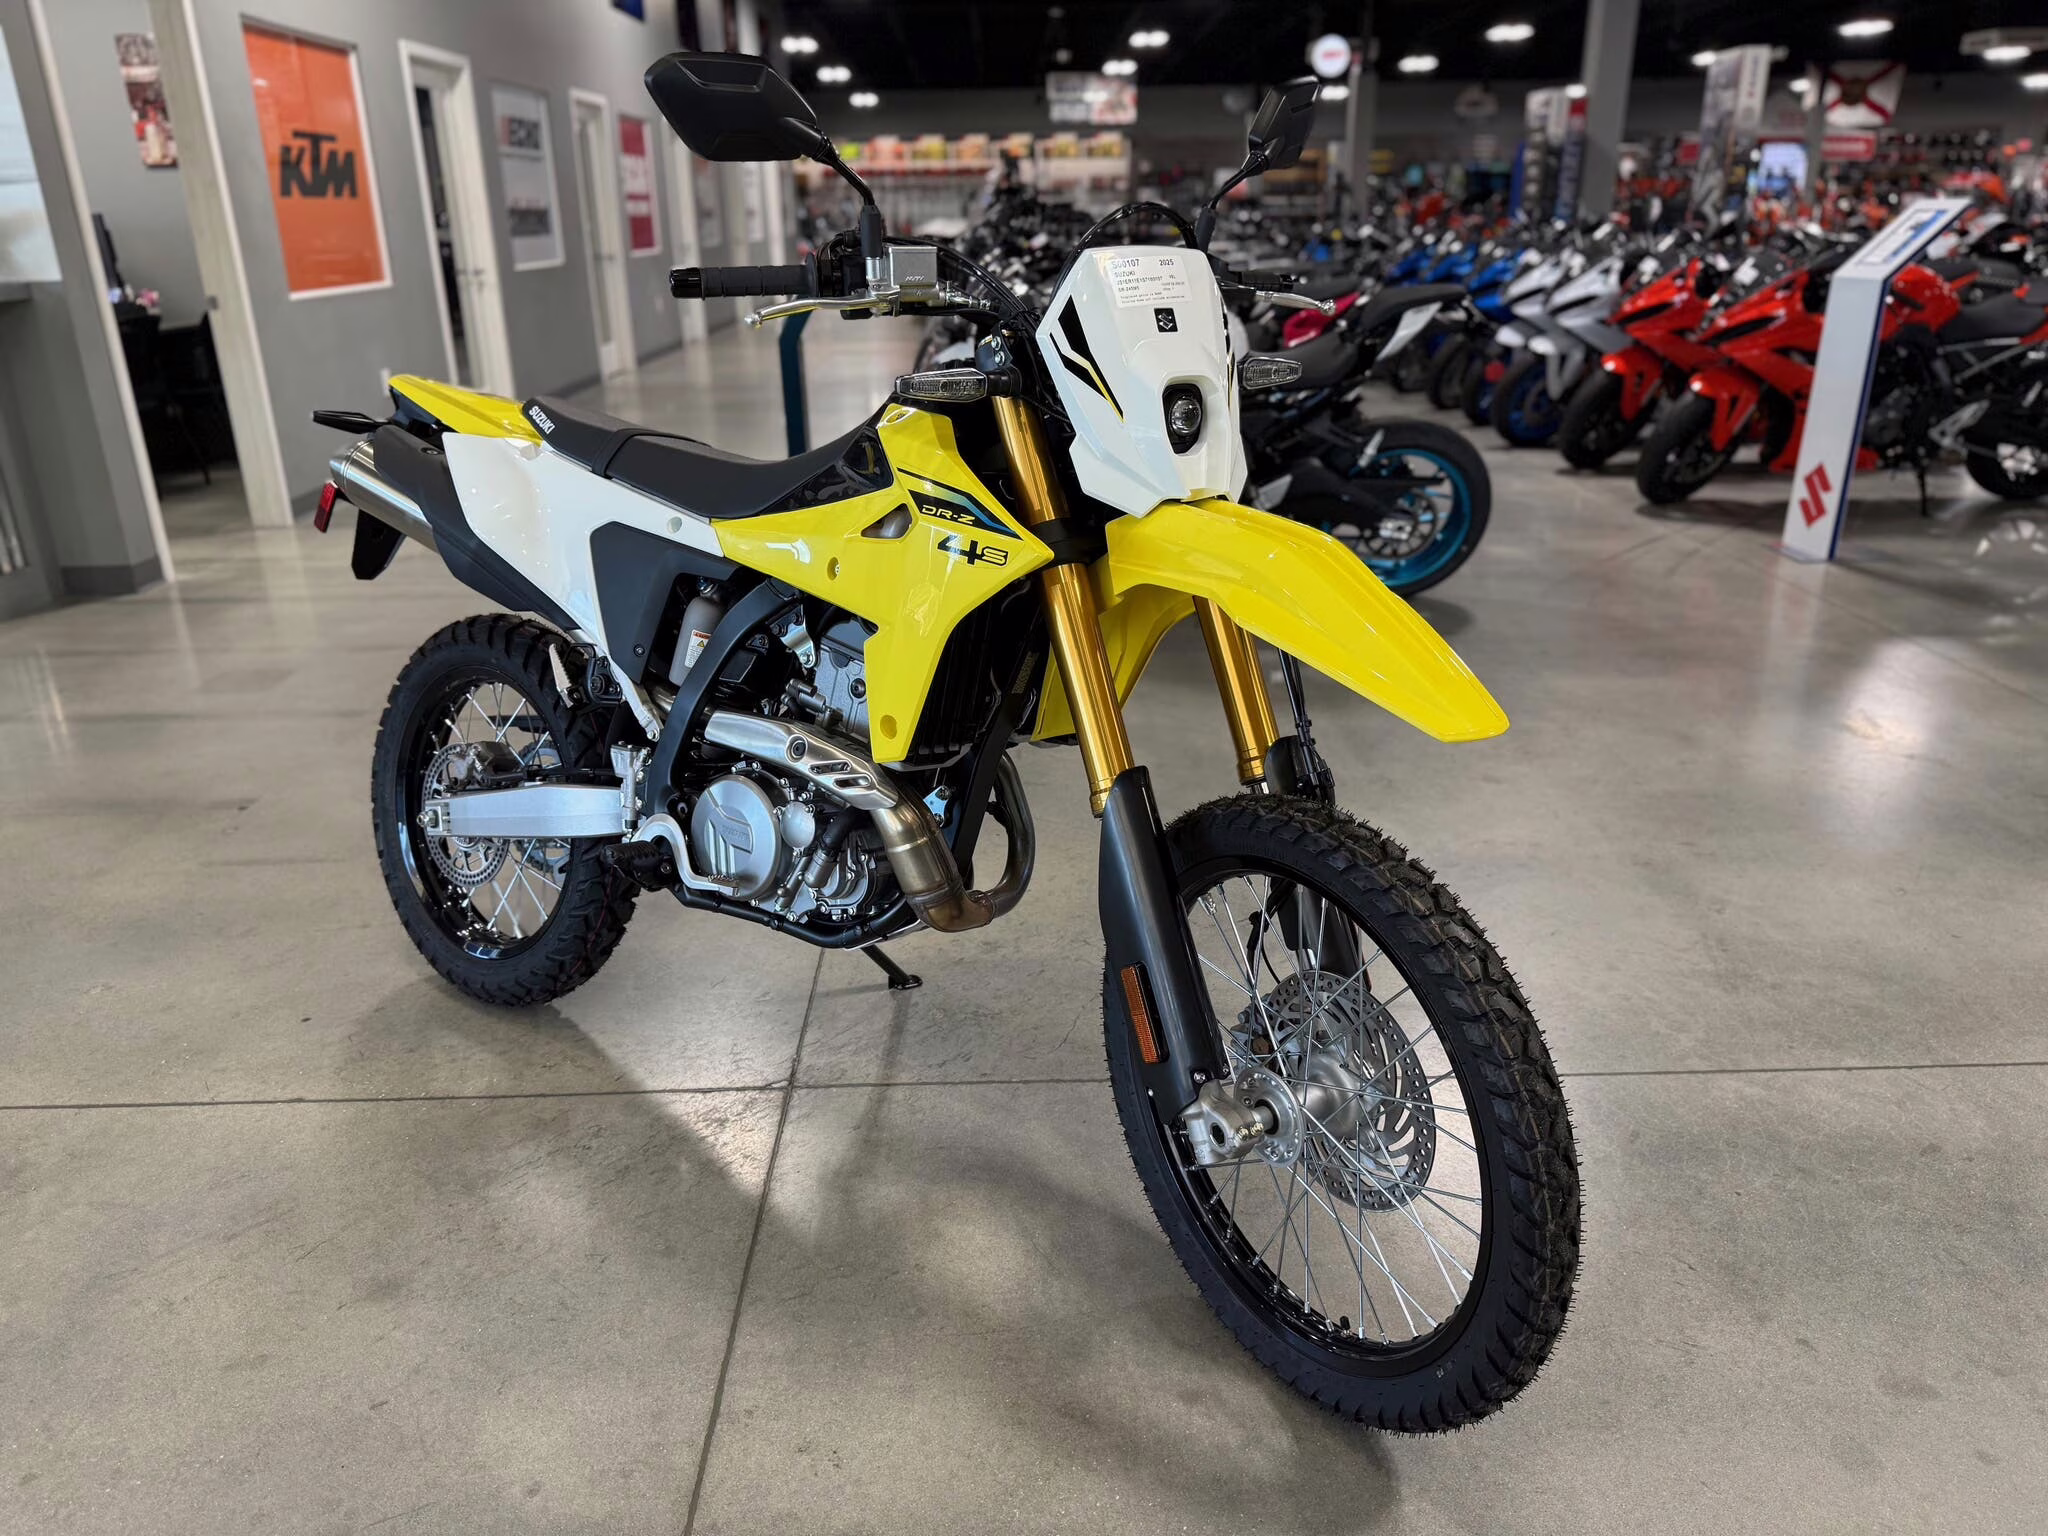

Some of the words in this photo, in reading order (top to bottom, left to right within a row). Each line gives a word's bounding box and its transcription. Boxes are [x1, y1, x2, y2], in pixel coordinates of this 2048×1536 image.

[280, 131, 357, 198] KTM
[1114, 270, 1136, 278] SUZUKI
[528, 405, 556, 435] SUZUKI
[921, 504, 976, 525] DR-Z
[937, 534, 1008, 566] 4S
